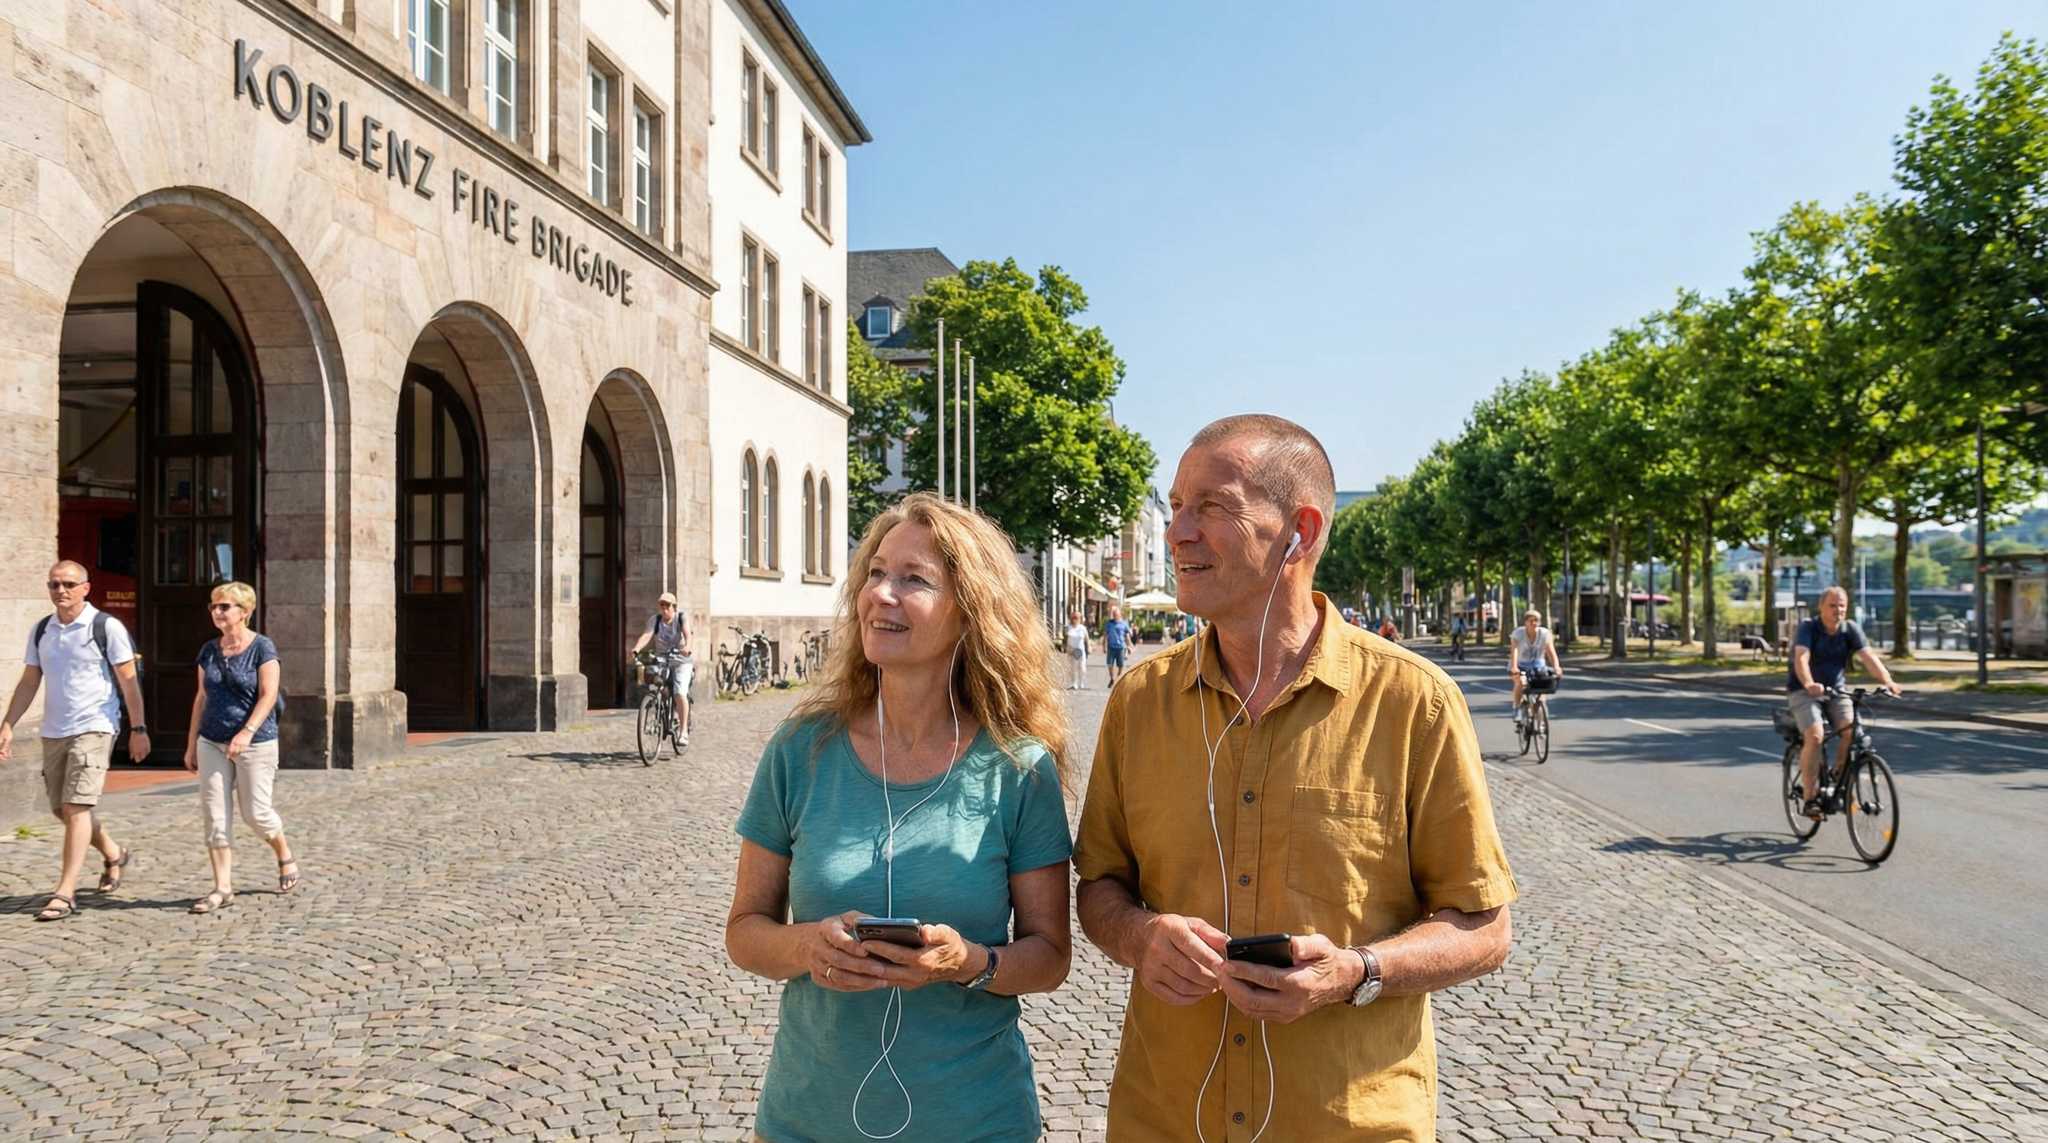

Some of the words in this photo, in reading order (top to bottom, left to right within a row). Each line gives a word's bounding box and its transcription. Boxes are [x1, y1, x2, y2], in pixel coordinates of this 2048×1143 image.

[234, 38, 435, 200] KOBLENZ
[453, 168, 519, 245] FIRE
[532, 216, 633, 307] BRIGADE
